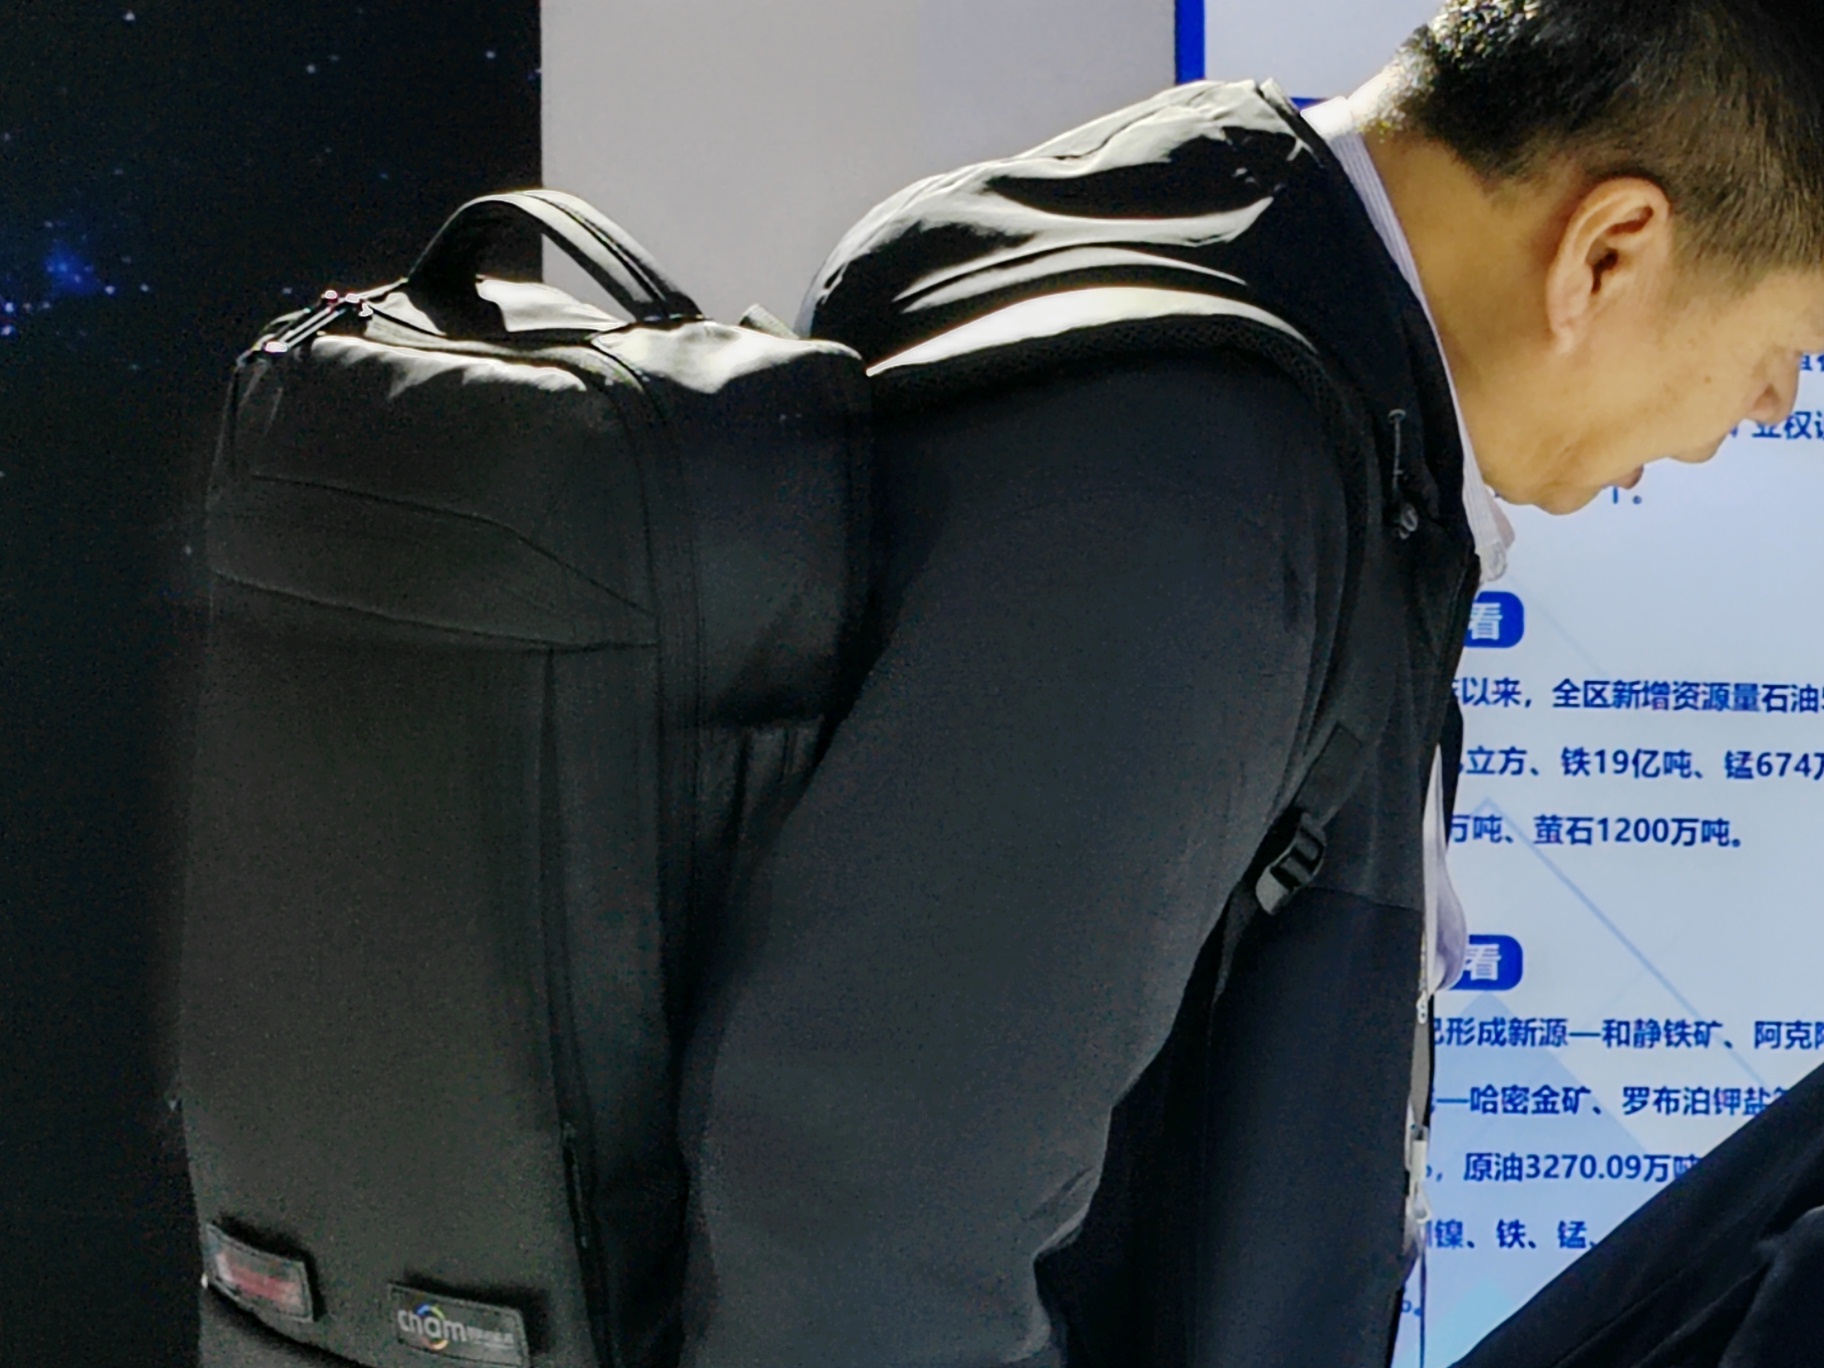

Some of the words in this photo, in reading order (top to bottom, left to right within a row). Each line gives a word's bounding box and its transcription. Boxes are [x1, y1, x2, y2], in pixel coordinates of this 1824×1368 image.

[1469, 602, 1503, 641] 看
[1464, 943, 1501, 982] 看
[1431, 1085, 1790, 1117] —哈密金矿、罗布泊钾盐
[1425, 1152, 1700, 1184] ，原油3270.09万吨
[1426, 1219, 1603, 1250] 镍、铁、锰、
